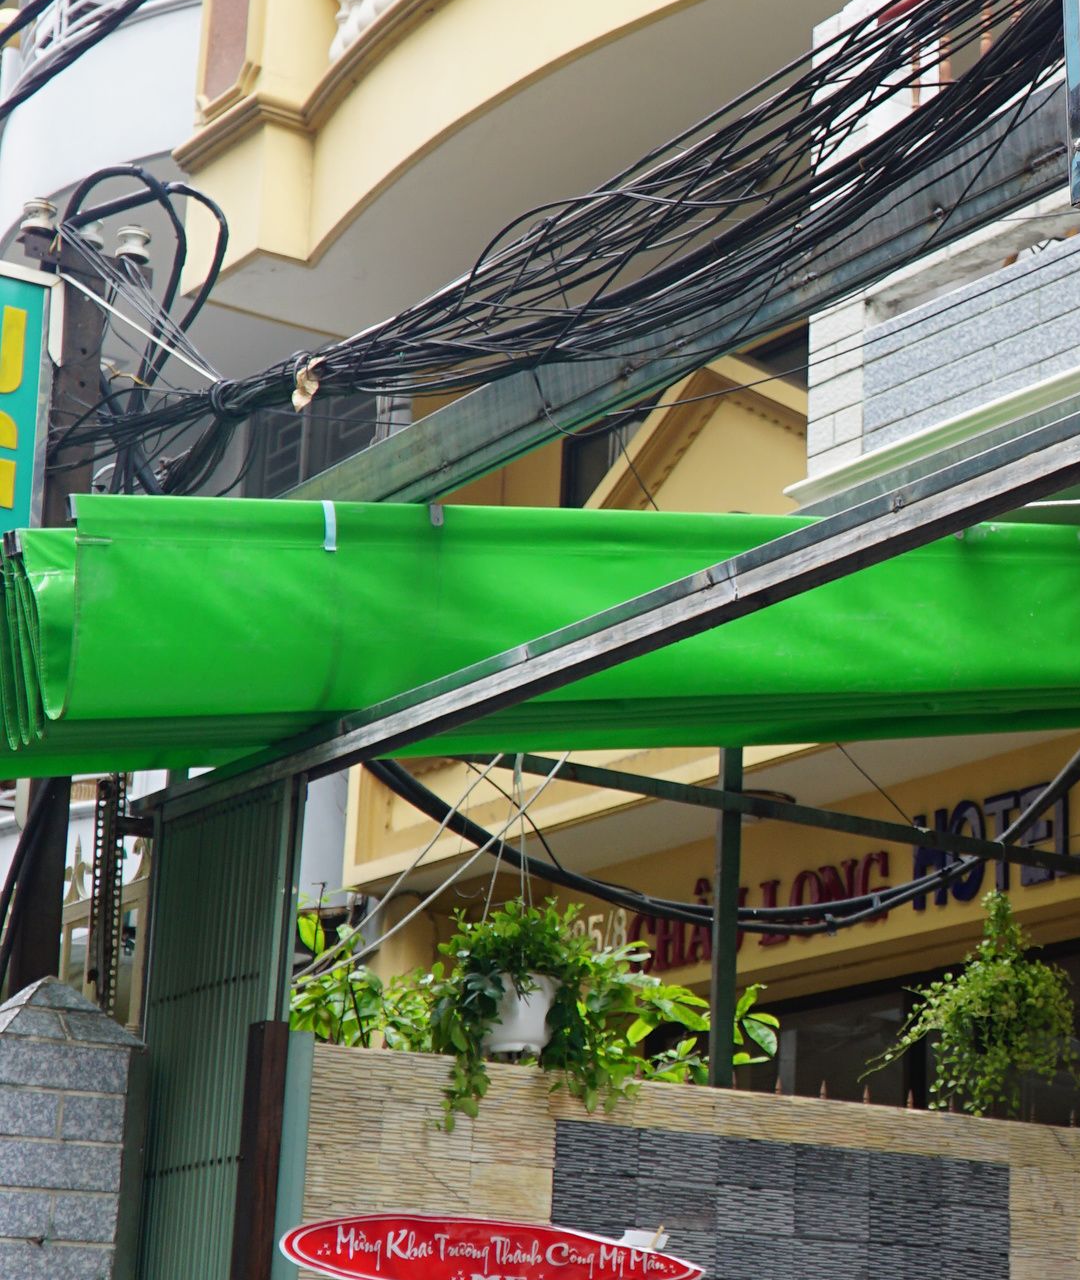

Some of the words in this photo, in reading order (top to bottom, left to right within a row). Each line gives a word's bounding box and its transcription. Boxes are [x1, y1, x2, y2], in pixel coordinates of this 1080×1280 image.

[386, 1229, 433, 1260] Khai
[490, 1236, 543, 1266] Thành
[545, 1242, 594, 1279] Công
